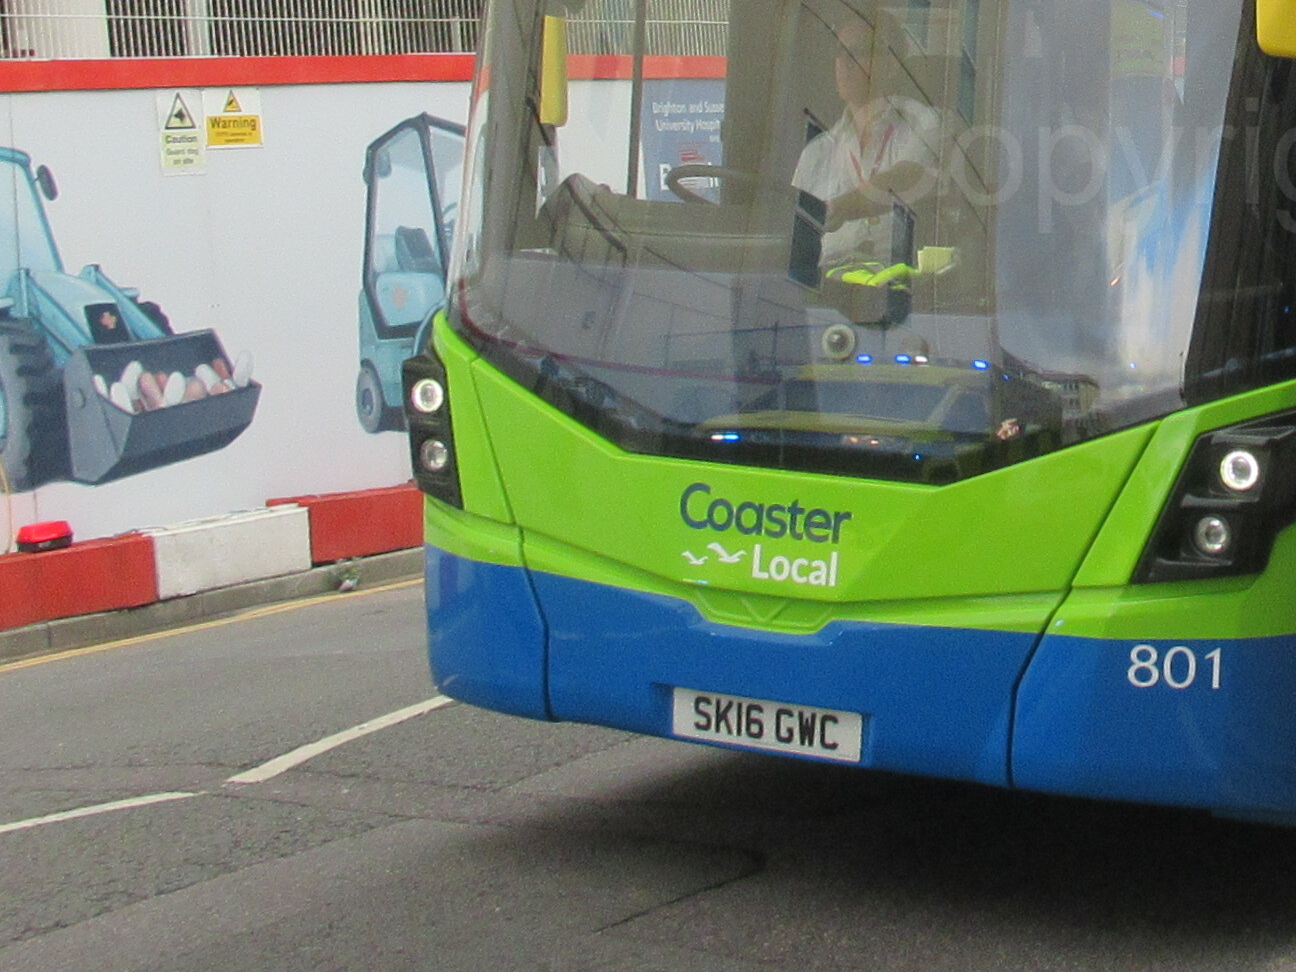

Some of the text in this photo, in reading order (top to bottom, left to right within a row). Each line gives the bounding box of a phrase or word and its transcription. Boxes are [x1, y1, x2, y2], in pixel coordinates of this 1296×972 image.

[209, 117, 257, 131] Warning
[652, 101, 686, 117] Brighton
[688, 101, 703, 113] and
[165, 134, 198, 144] Caution
[655, 118, 695, 133] University
[680, 482, 852, 544] Coaster
[751, 543, 839, 587] Local
[1126, 644, 1222, 690] 801
[693, 696, 839, 751] SK16 GWC
